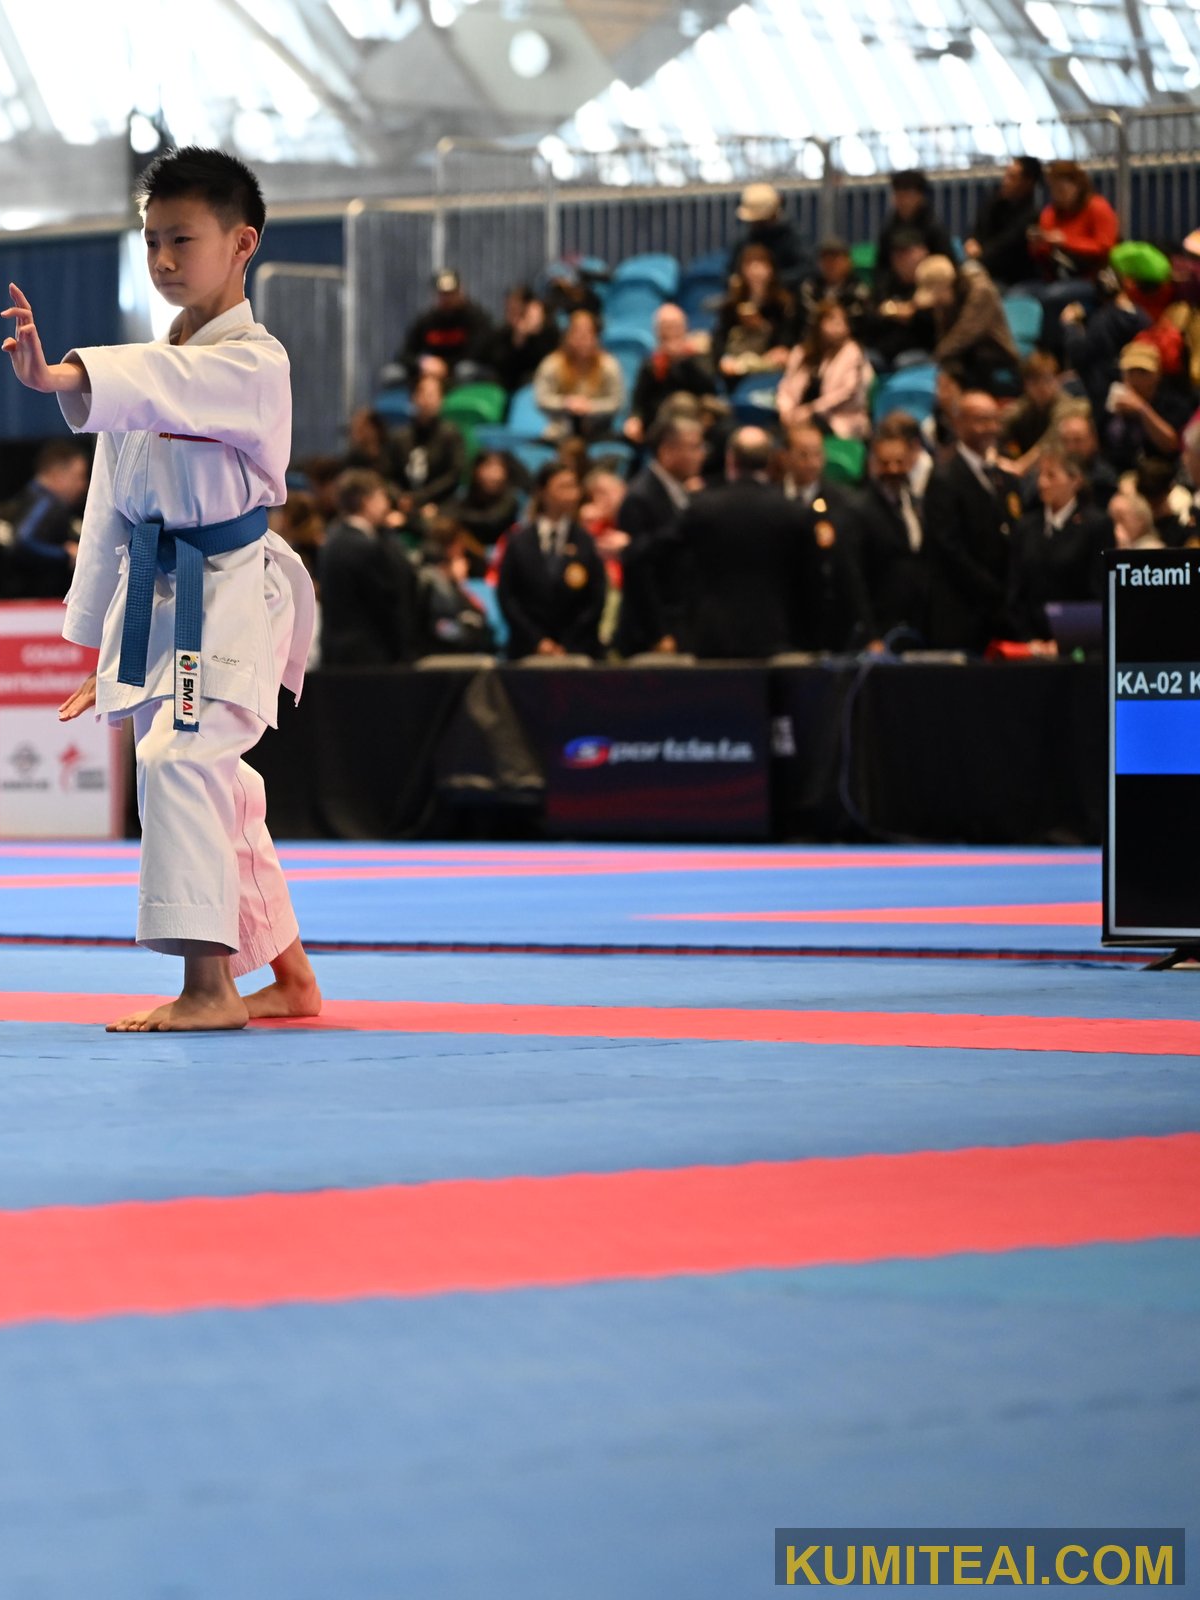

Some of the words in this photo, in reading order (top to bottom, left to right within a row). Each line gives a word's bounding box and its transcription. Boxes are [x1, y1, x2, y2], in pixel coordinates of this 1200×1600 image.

[1116, 562, 1190, 586] Tatami
[1117, 671, 1182, 694] KA-02
[182, 677, 194, 716] SMAI
